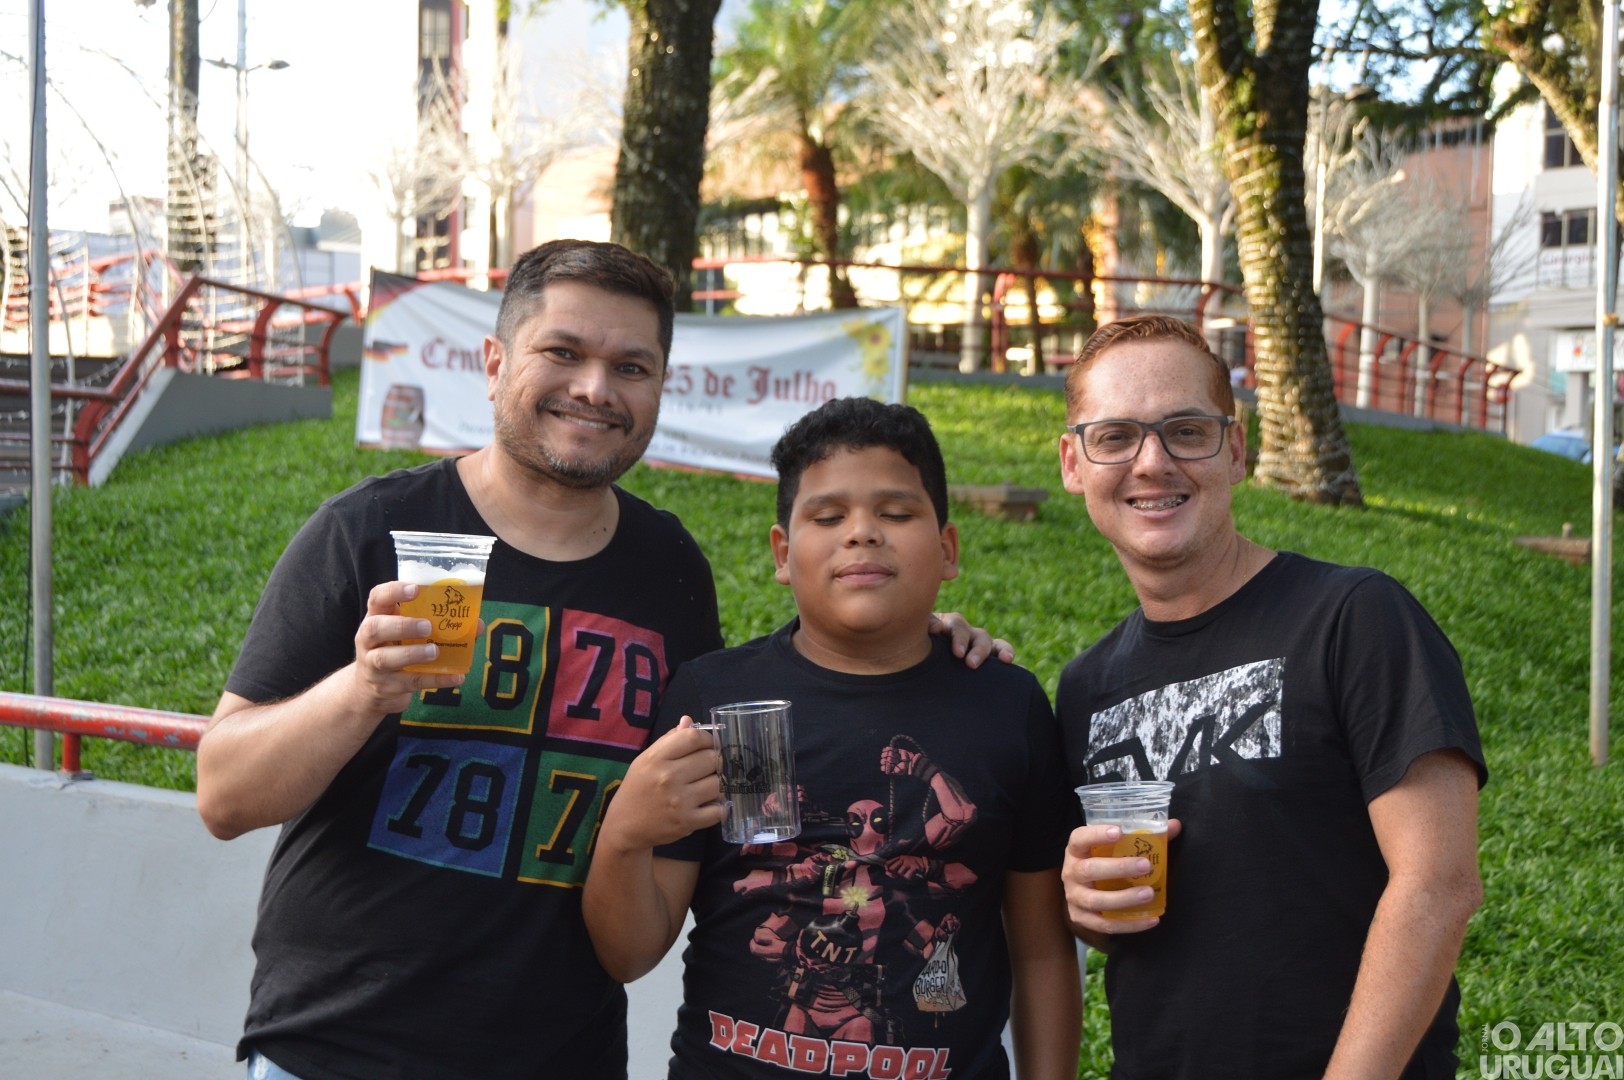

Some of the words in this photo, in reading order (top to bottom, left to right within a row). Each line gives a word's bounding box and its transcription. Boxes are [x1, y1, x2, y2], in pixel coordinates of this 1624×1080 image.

[420, 337, 486, 374] Cent
[703, 366, 735, 398] de
[746, 364, 836, 406] Julho
[431, 603, 471, 618] Wolff
[565, 629, 660, 729] 78
[385, 754, 506, 852] 78
[709, 1010, 952, 1080] DEADPOOL
